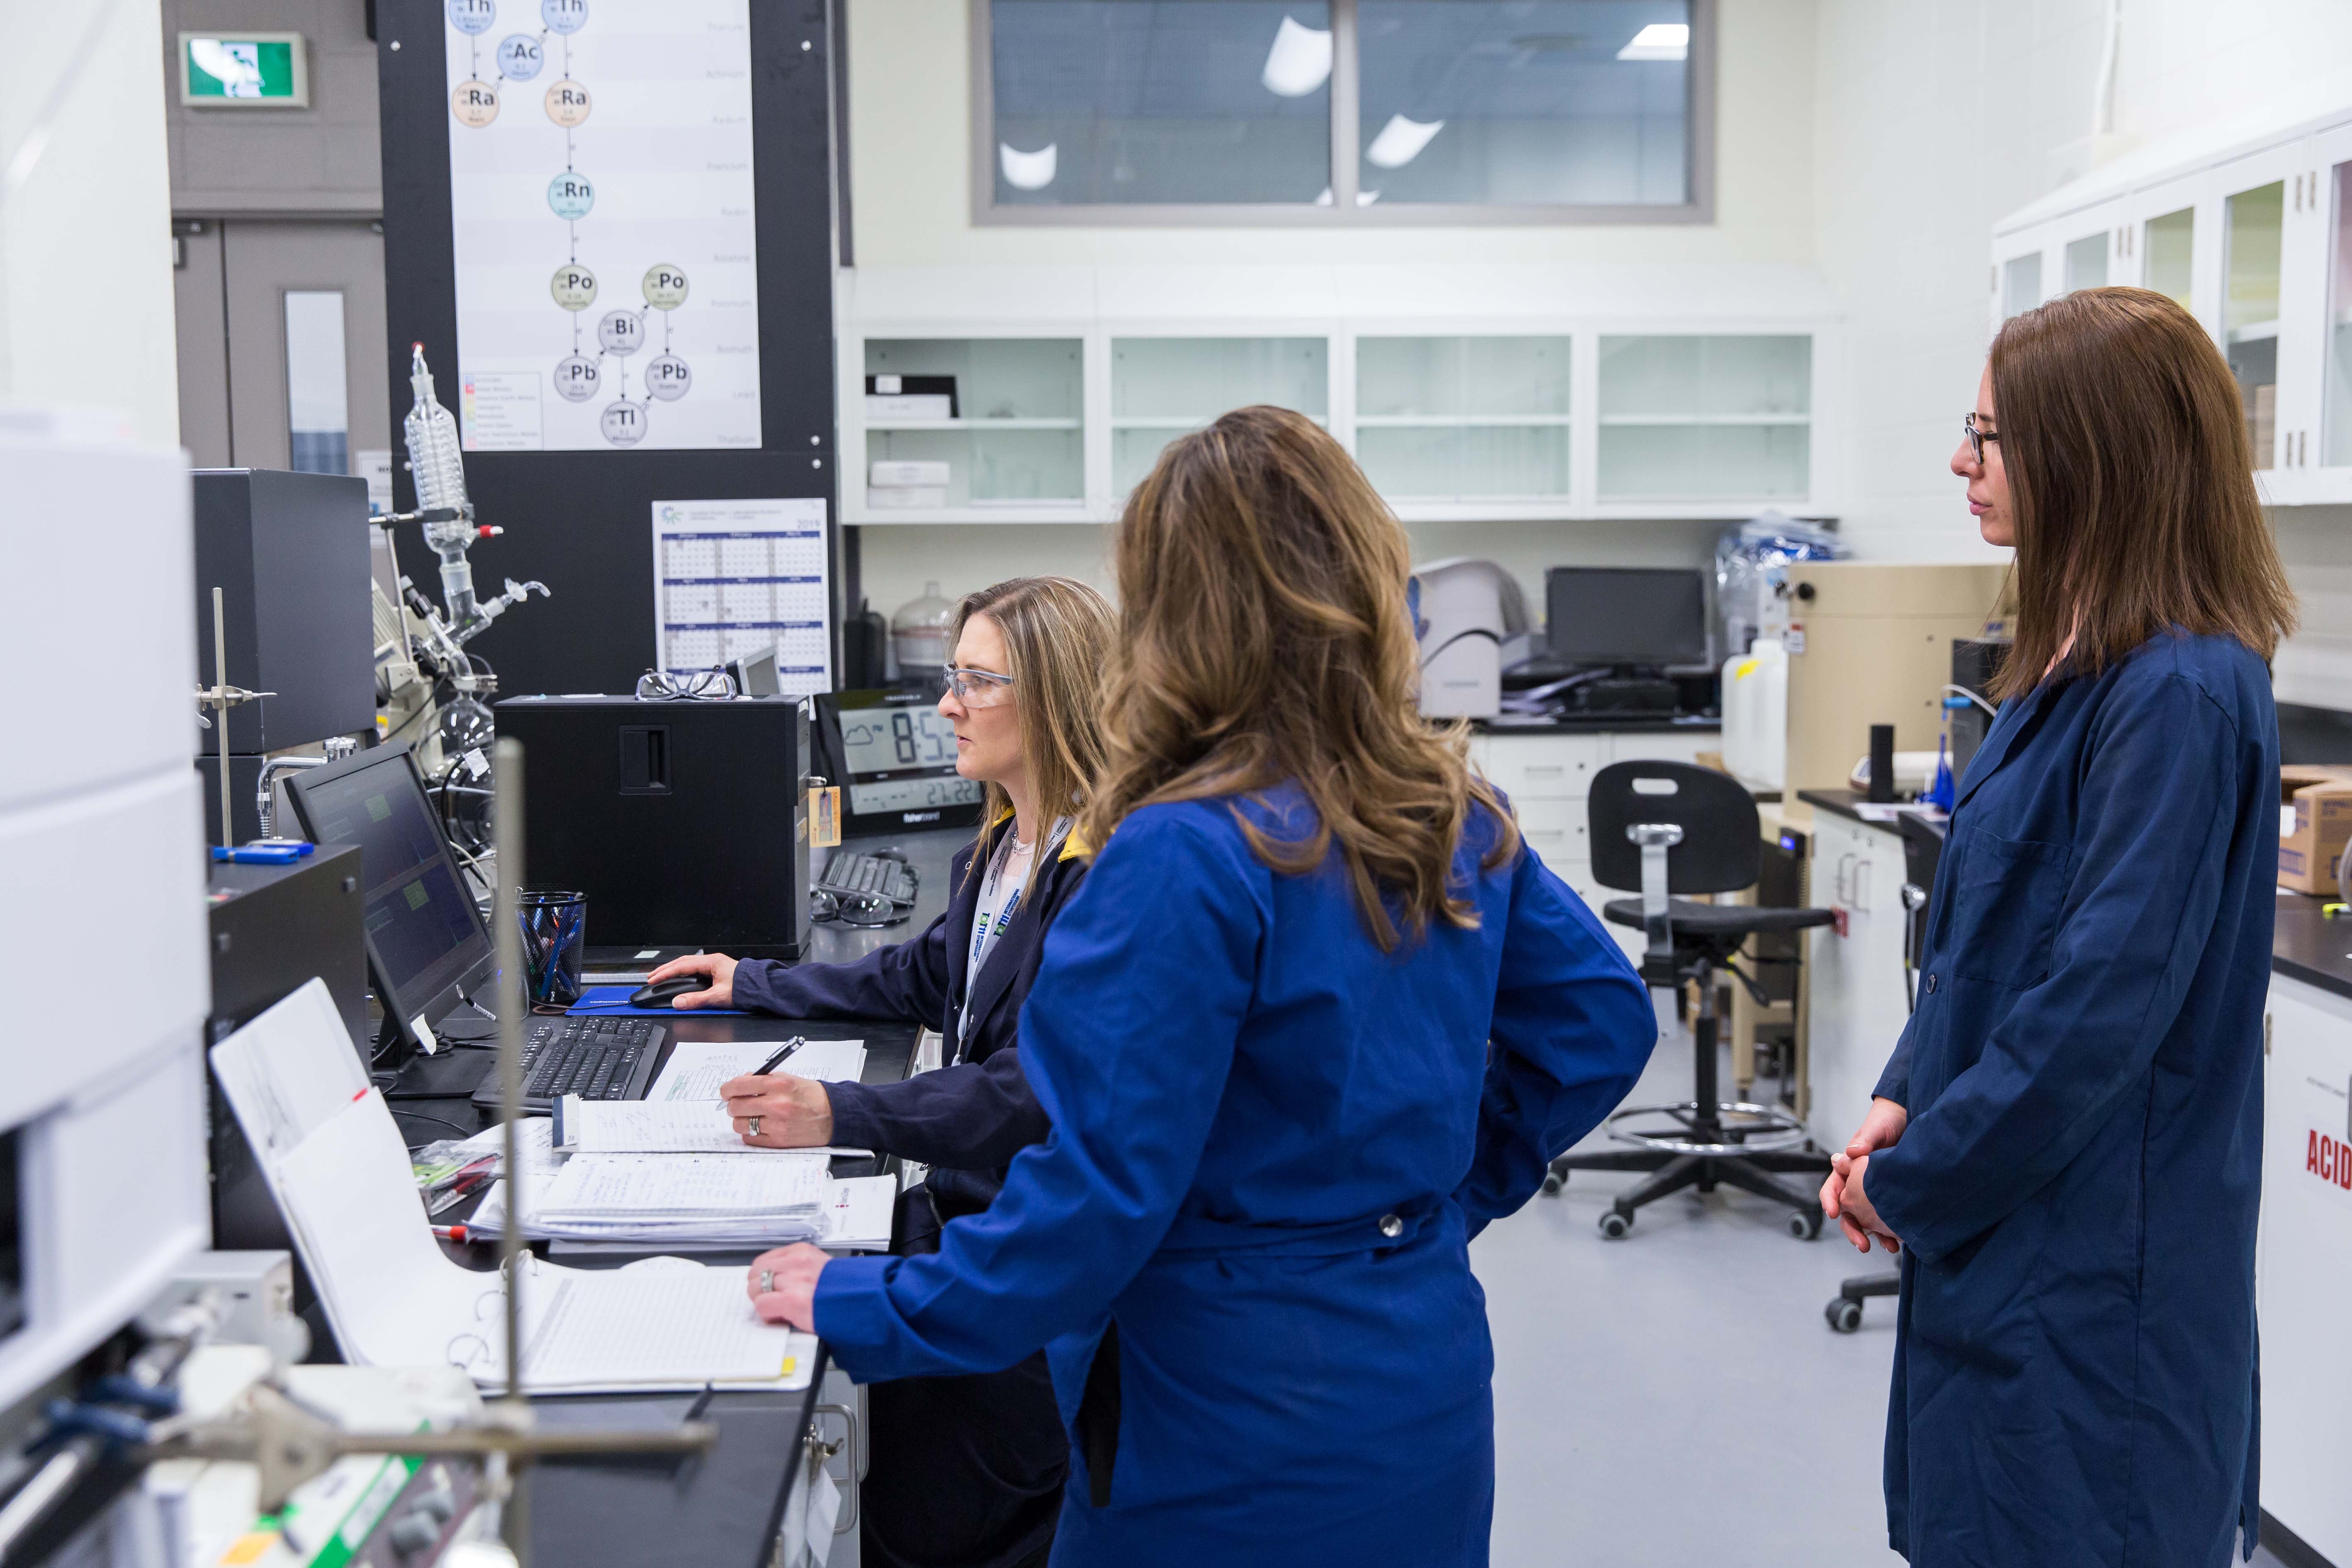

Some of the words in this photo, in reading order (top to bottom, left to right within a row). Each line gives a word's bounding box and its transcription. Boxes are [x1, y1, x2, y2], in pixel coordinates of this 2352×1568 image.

[466, 0, 490, 12] Th
[558, 0, 583, 12] Th
[514, 43, 538, 59] Ac
[470, 90, 494, 106] Ra
[562, 90, 586, 105] Ra
[565, 182, 590, 197] Rn
[568, 273, 592, 289] Po
[659, 273, 684, 289] Po
[616, 318, 634, 334] Bi
[572, 365, 596, 380] Pb
[662, 364, 687, 379] Pb
[617, 410, 635, 425] Tl
[797, 519, 820, 529] 2019
[1004, 888, 1020, 914] INTERNATIONAL
[1007, 895, 1020, 916] SYMPOSIUM
[975, 936, 984, 963] INTERNATIONAL
[2306, 1128, 2352, 1190] ACID
